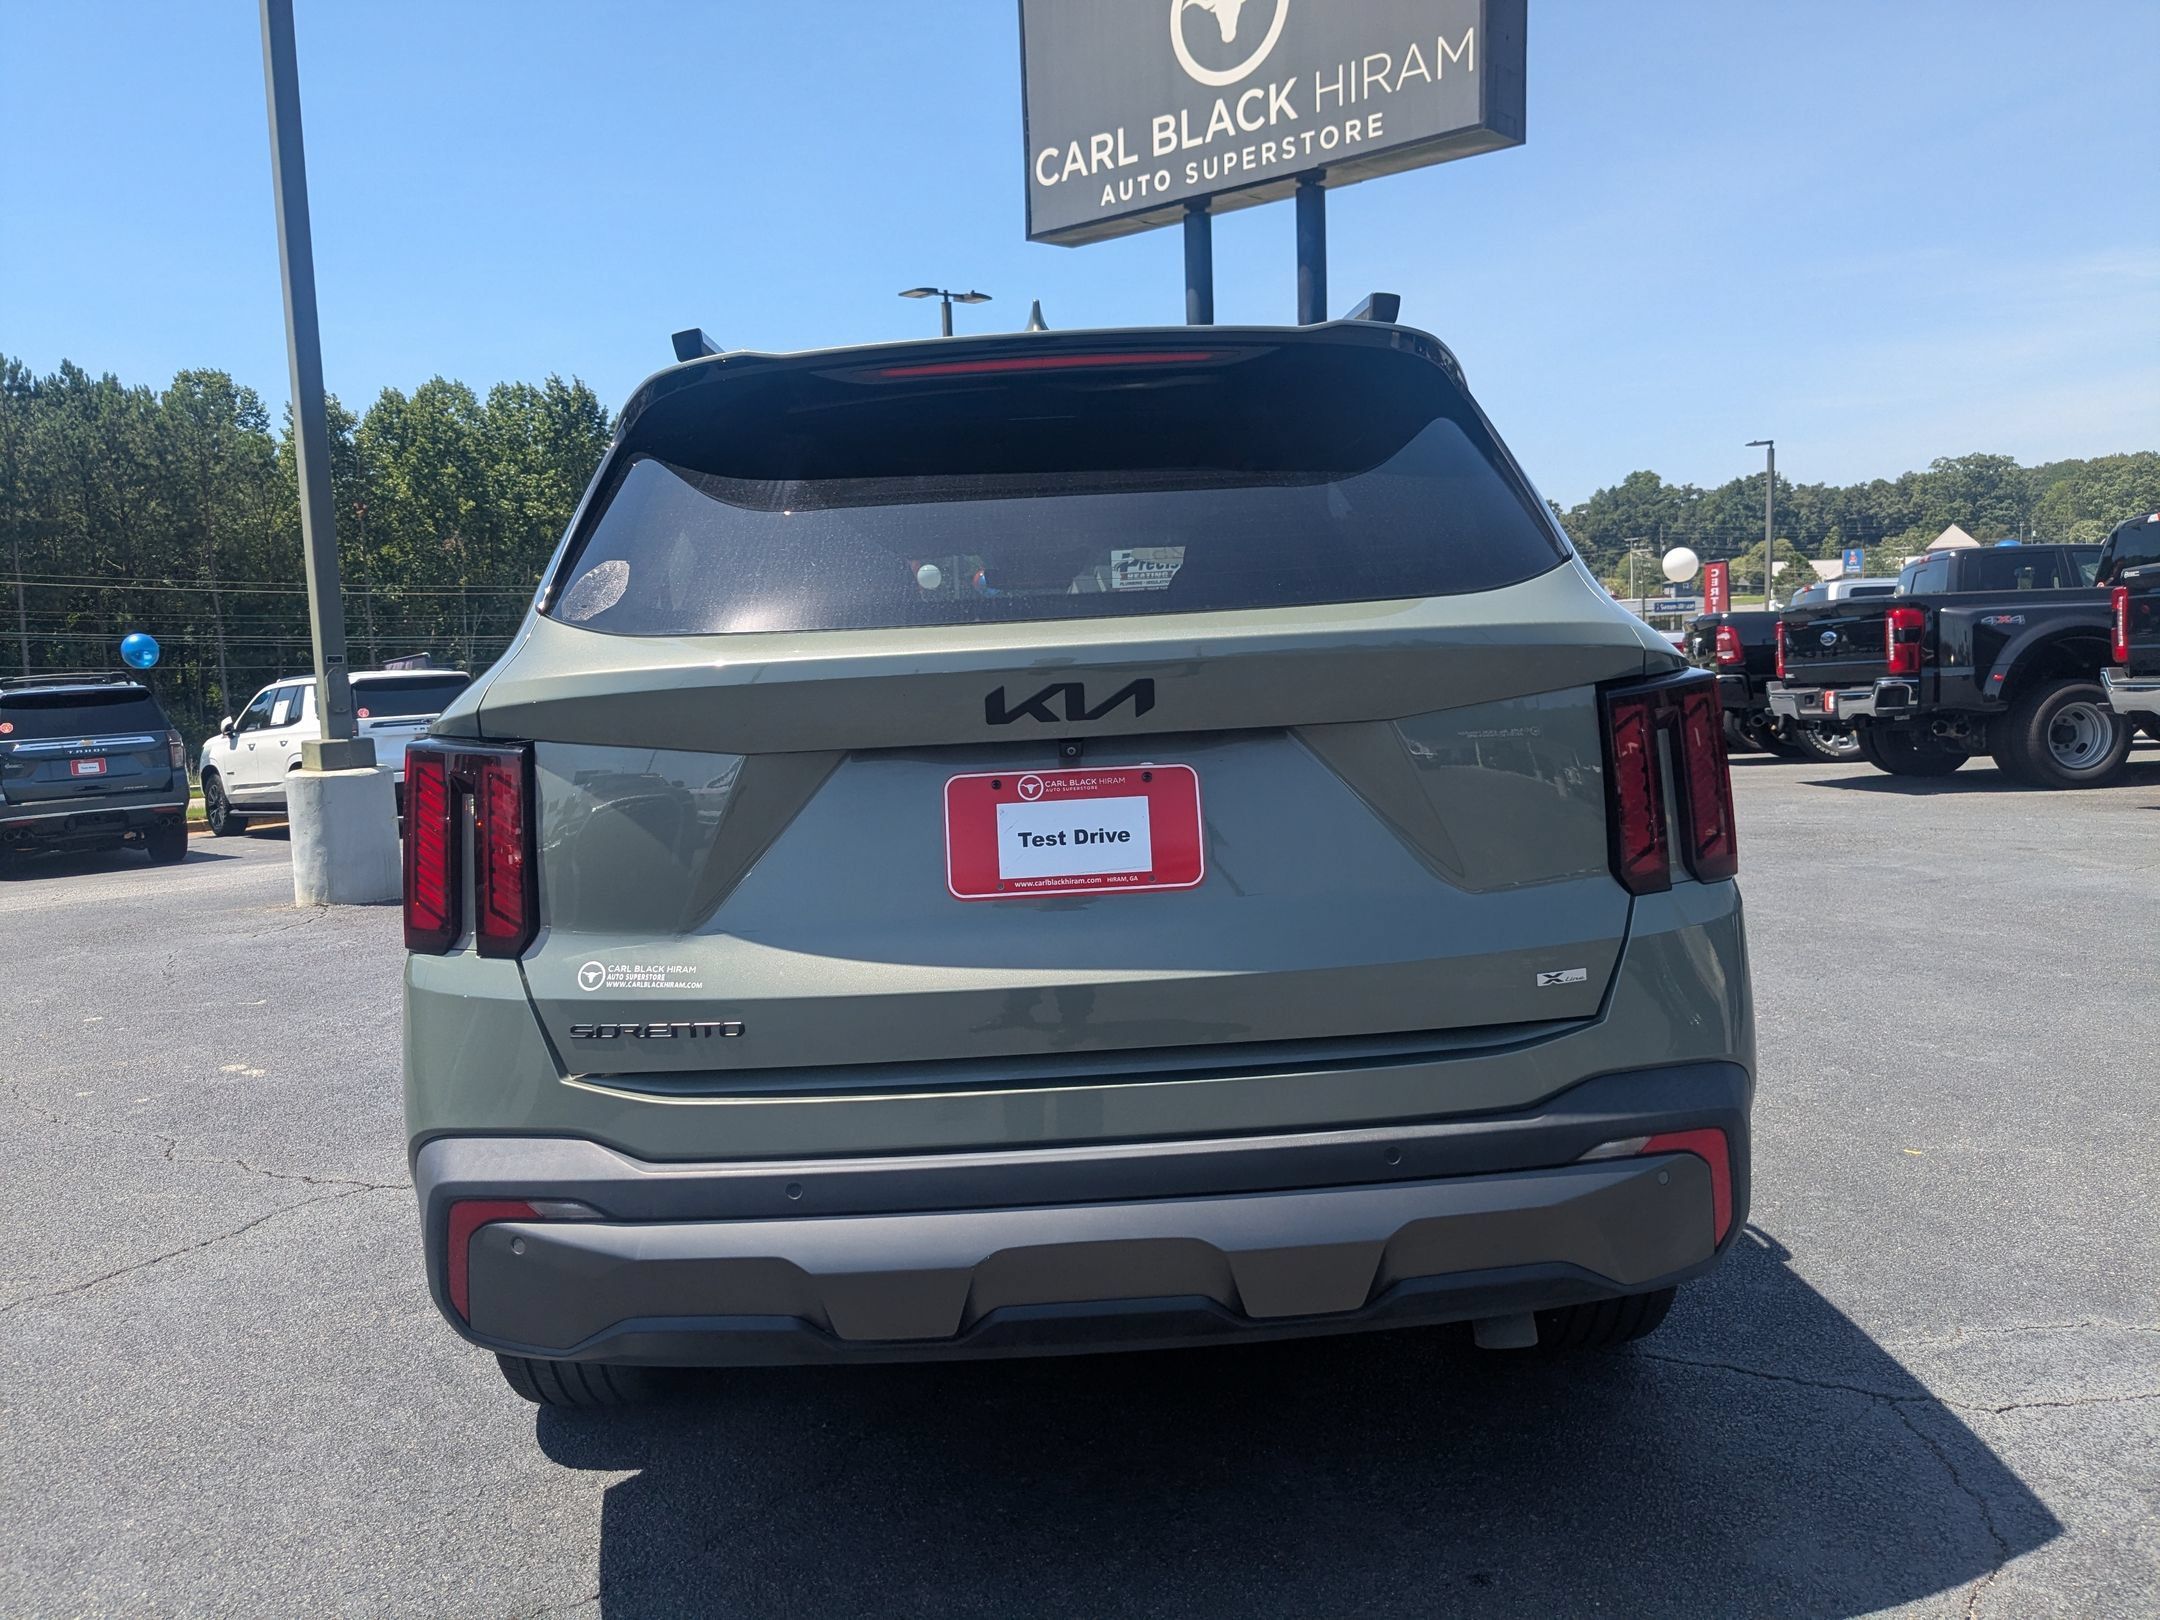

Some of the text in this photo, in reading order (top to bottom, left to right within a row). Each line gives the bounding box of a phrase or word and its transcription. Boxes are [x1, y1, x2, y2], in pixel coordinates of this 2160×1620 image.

[1035, 27, 1475, 187] CARL BLACK HIRAM
[1101, 112, 1384, 206] AUTO SUPERSTORE
[985, 678, 1155, 725] KIA
[1044, 777, 1126, 788] CARL BLACK HIRAM
[1017, 828, 1131, 848] Test Drive
[1014, 877, 1102, 888] www.carlblackhiram.com
[607, 964, 697, 974] CARL BLACK HIRAM
[606, 973, 666, 981] AUTO SUPERSTORE
[606, 981, 703, 989] WWW.CARLBLACKHIRAM.COM
[570, 1021, 746, 1039] SORENTO
